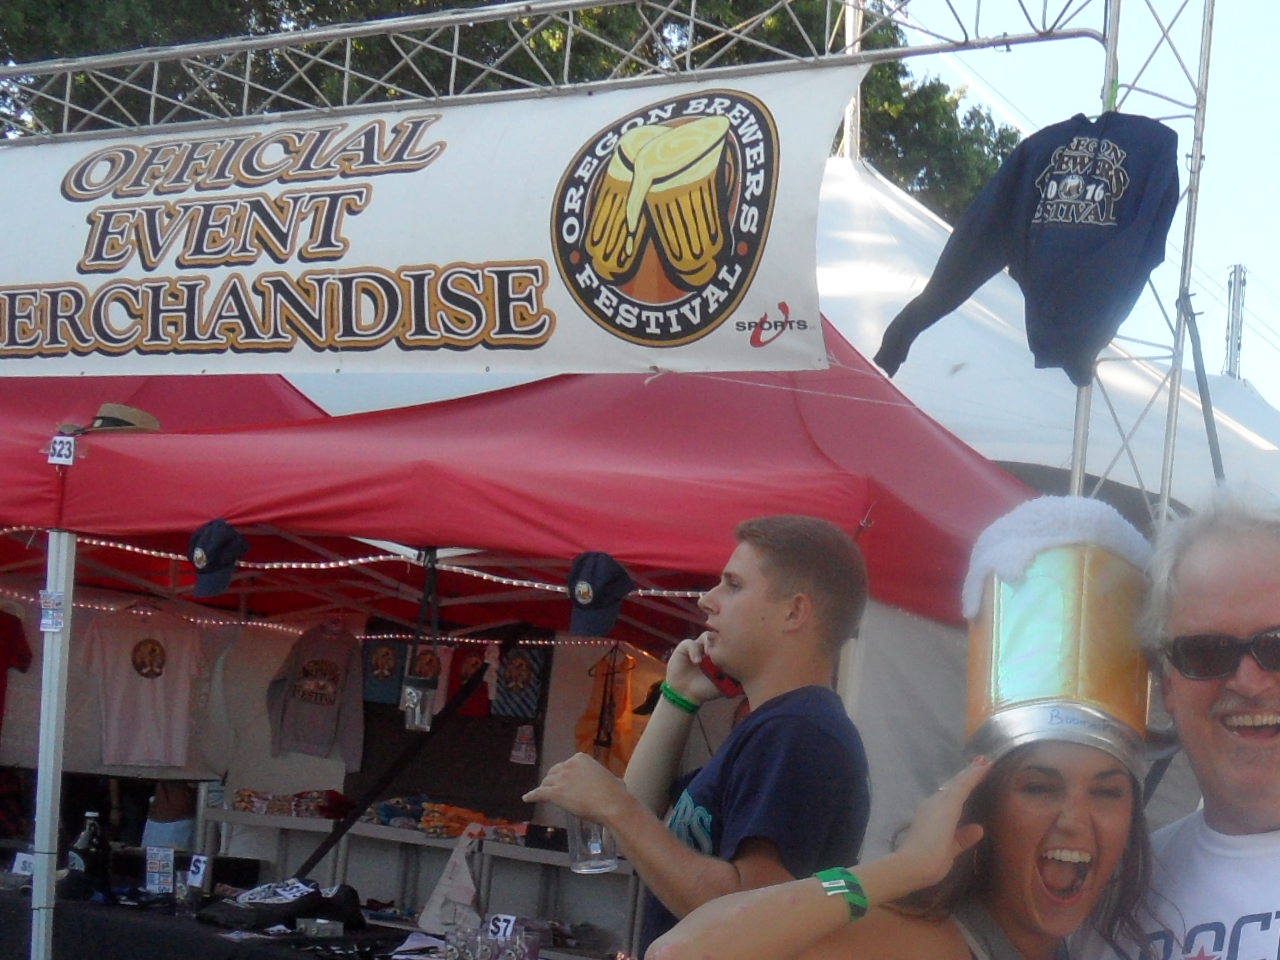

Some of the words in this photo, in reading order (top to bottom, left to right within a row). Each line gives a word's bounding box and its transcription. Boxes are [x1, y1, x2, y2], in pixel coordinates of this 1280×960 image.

[61, 114, 447, 201] OFFICIAL
[562, 103, 677, 244] OREGON
[682, 97, 765, 235] BREWERS
[77, 183, 373, 274] EVENT
[0, 261, 556, 358] ERCHANDISE
[575, 263, 743, 335] FESTIVAL
[736, 319, 808, 333] SPORTS
[51, 440, 73, 459] $23
[490, 915, 511, 937] $7
